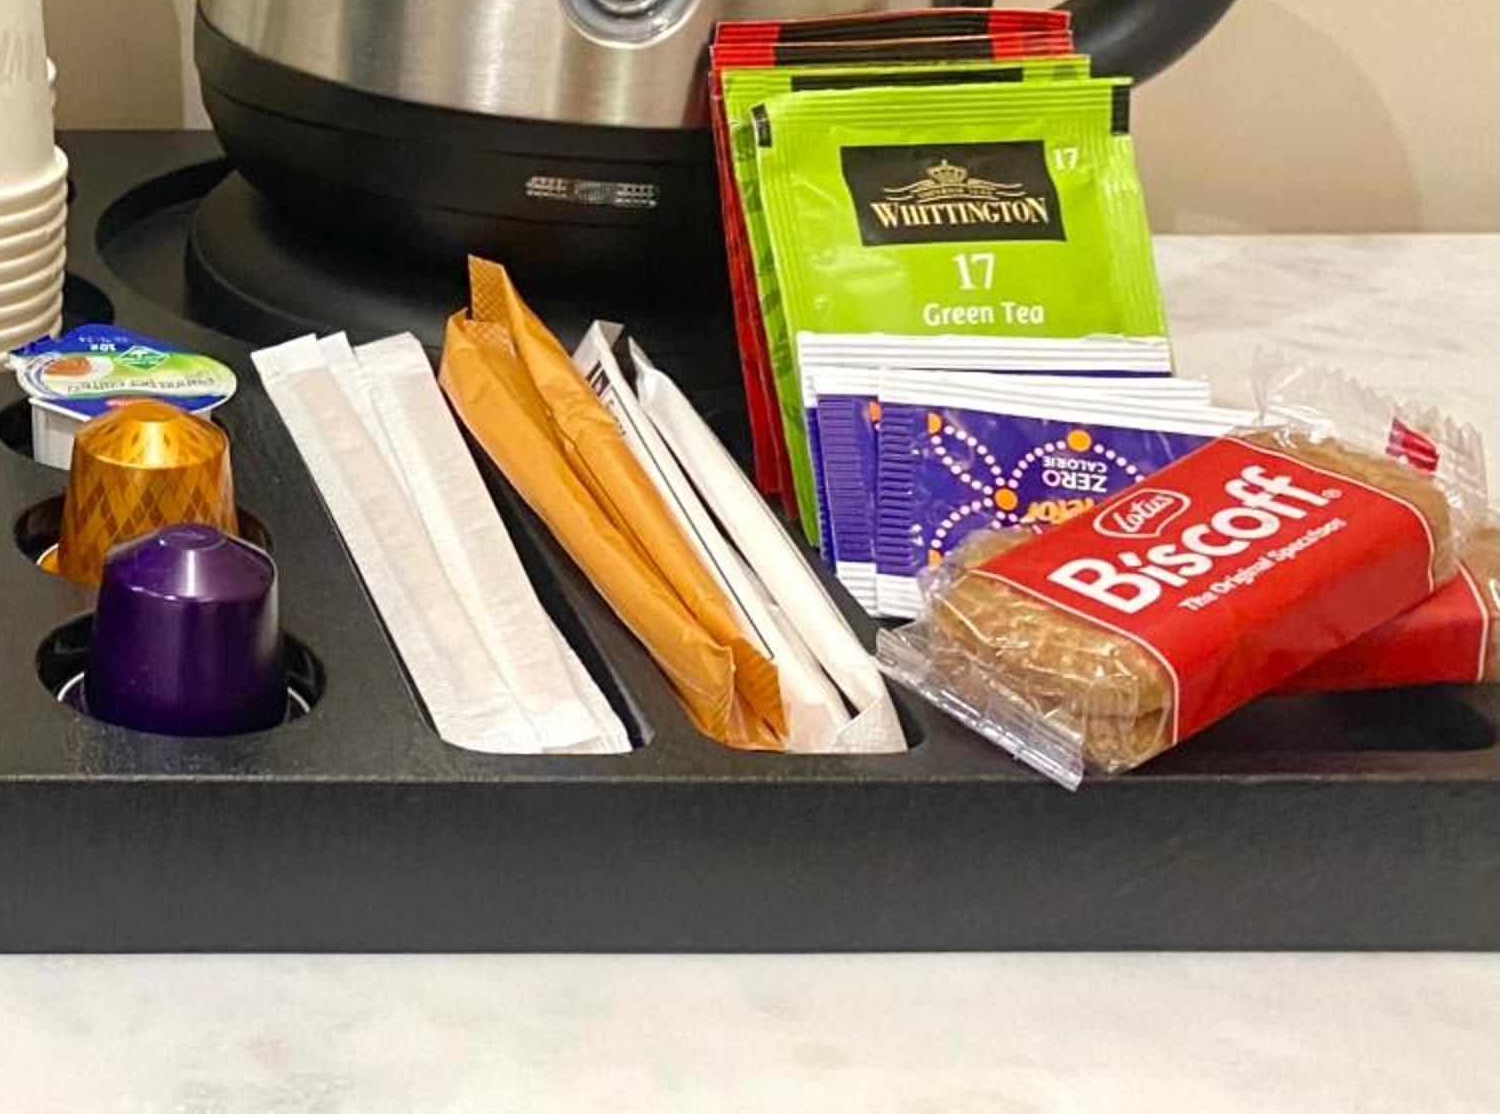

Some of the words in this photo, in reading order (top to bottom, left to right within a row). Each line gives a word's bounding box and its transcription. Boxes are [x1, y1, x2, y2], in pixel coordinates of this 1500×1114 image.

[1052, 147, 1078, 170] 17
[870, 197, 1050, 229] WHITTINGTON
[953, 252, 997, 291] 17
[923, 304, 995, 327] Green
[1001, 301, 1045, 325] Tea
[1042, 456, 1107, 473] CALORIE
[1042, 471, 1107, 493] ZERO
[1112, 493, 1175, 533] Lotus
[1047, 465, 1331, 615] Biscoff
[1177, 591, 1219, 611] The
[1209, 556, 1276, 595] Original
